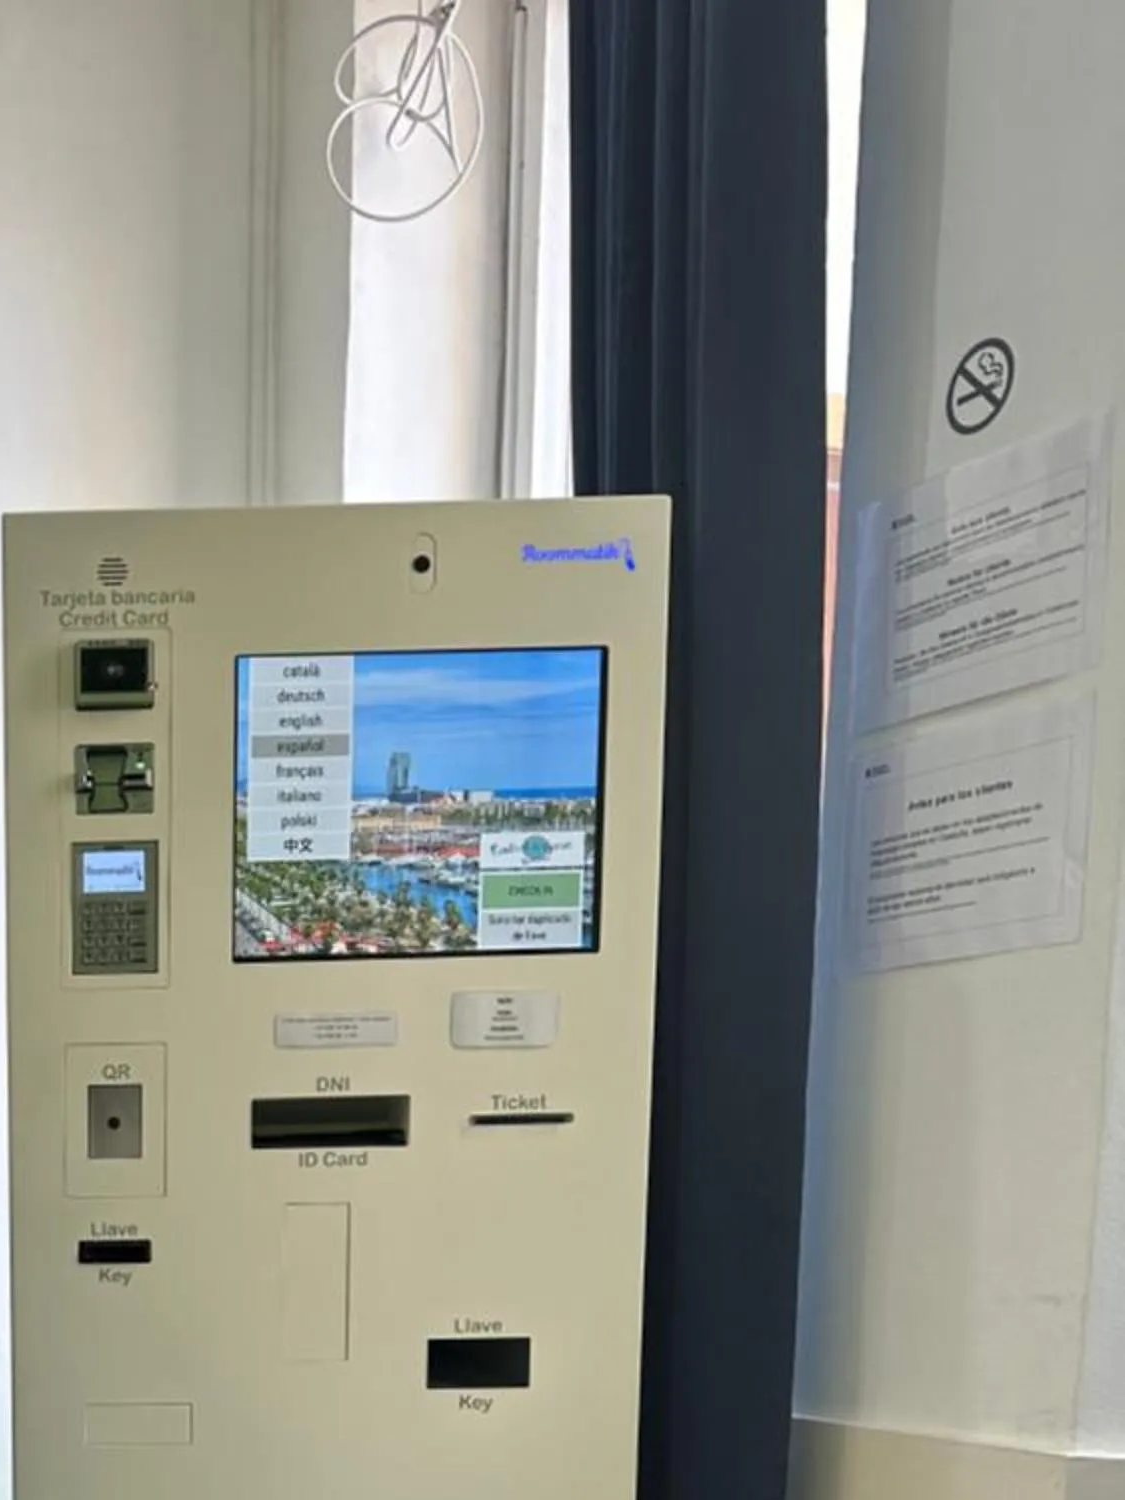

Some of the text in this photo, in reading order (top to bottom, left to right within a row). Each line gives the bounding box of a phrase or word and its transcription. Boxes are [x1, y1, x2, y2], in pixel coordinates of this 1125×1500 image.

[39, 588, 196, 610] Tarjeta bancaria
[59, 609, 170, 628] Credit Card
[283, 662, 320, 678] català
[277, 690, 325, 703] deutsch
[279, 714, 323, 730] english
[277, 738, 325, 754] español
[276, 764, 324, 779] français
[277, 788, 321, 802] italiano
[281, 814, 317, 830] polski
[283, 837, 314, 853] 中文
[101, 1063, 132, 1081] QR
[316, 1076, 350, 1092] DNI
[491, 1094, 546, 1110] Ticket
[299, 1151, 368, 1168] ID Card
[91, 1221, 138, 1237] Llave
[98, 1268, 133, 1287] Key
[454, 1317, 503, 1334] Llave
[458, 1394, 494, 1414] Key
